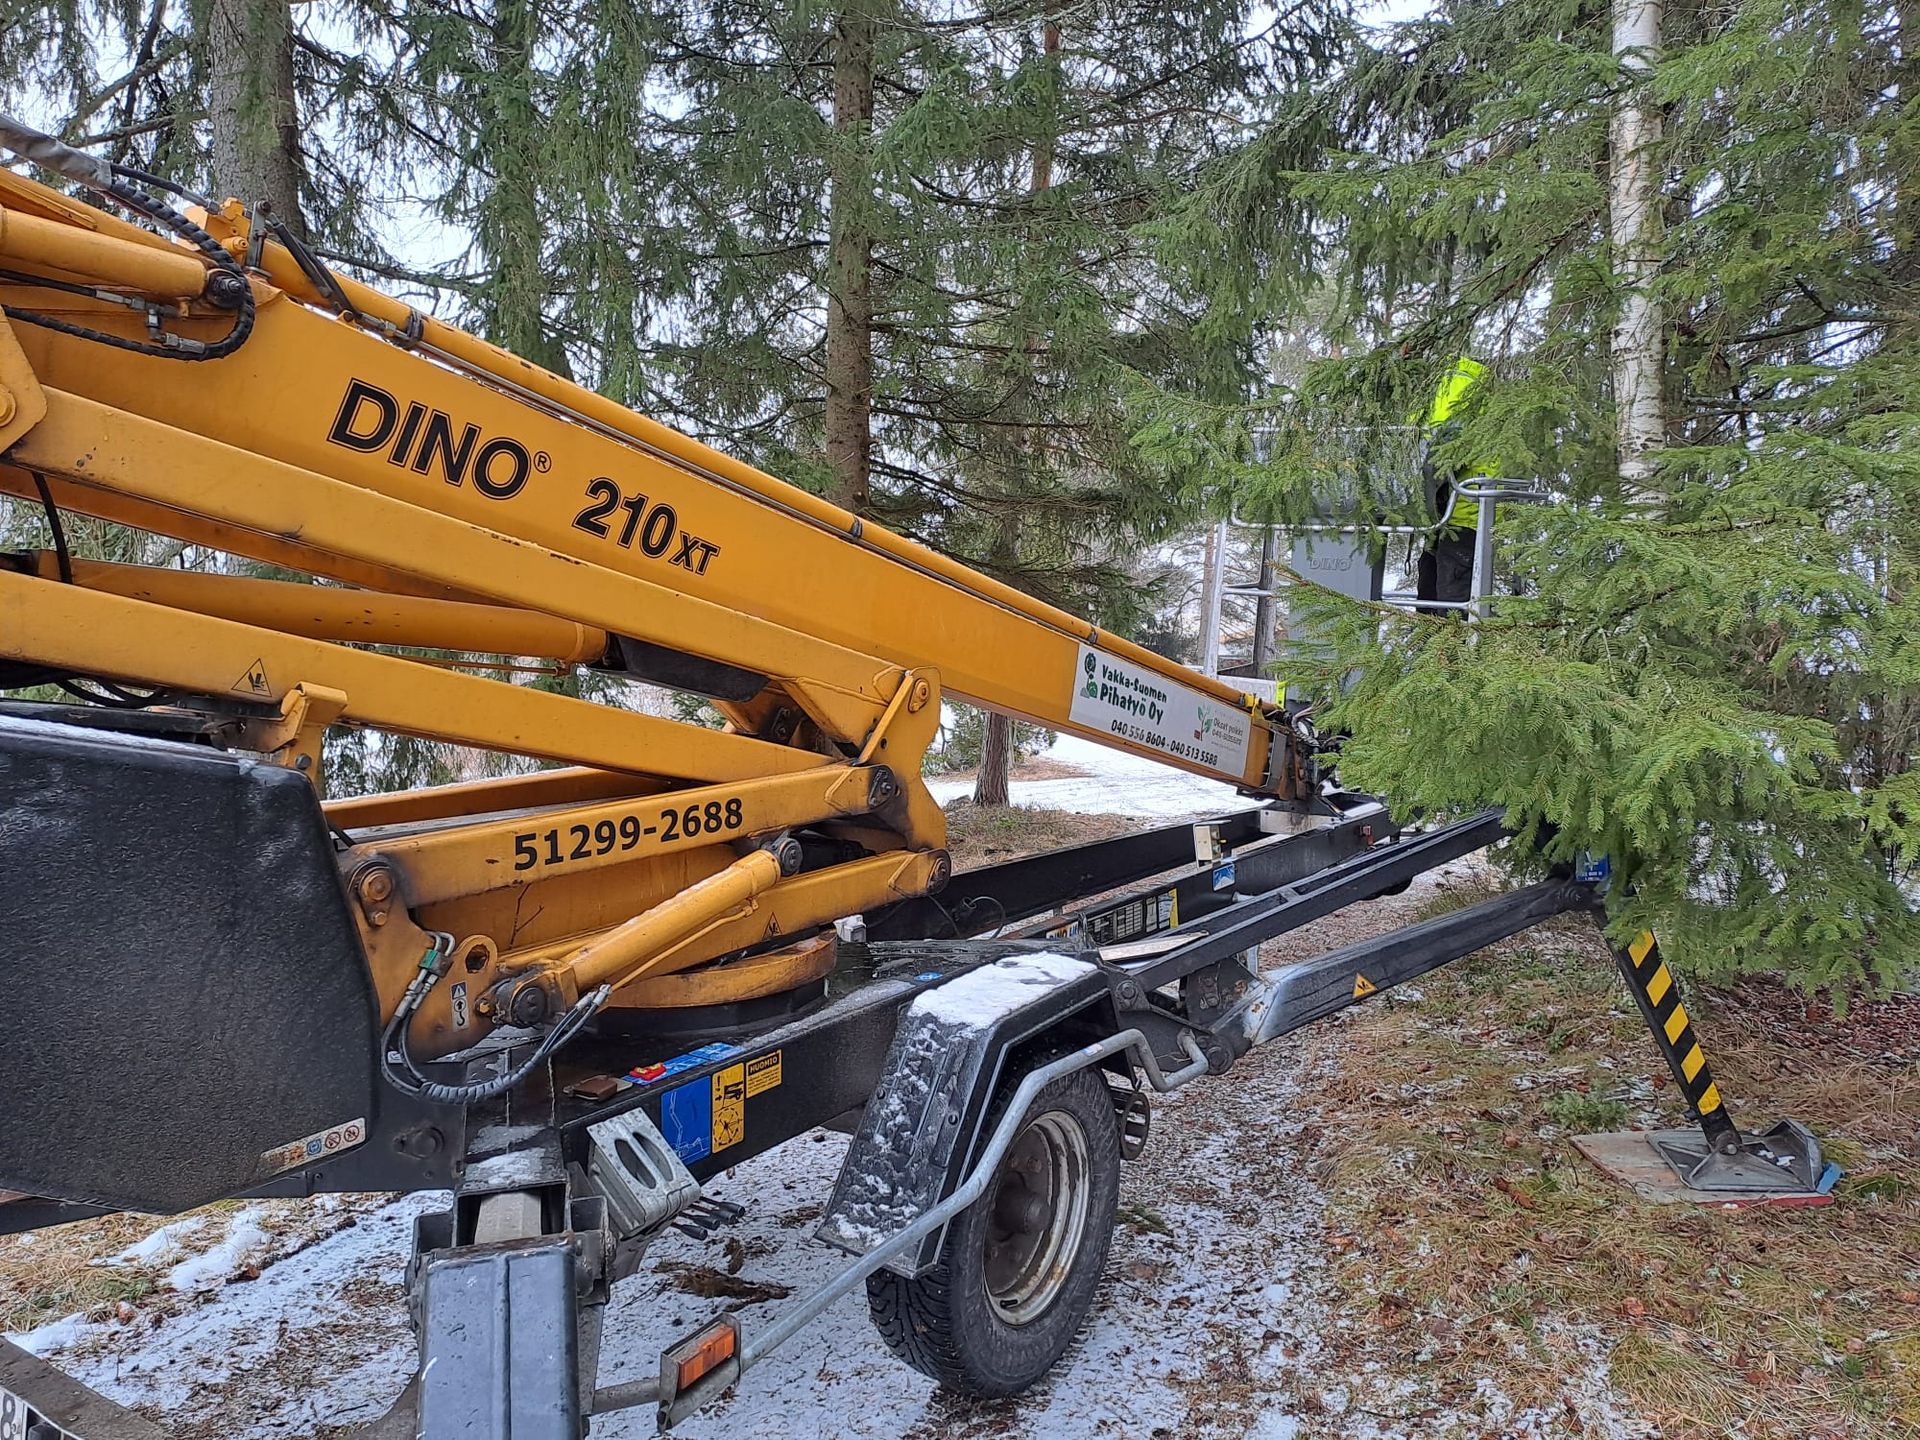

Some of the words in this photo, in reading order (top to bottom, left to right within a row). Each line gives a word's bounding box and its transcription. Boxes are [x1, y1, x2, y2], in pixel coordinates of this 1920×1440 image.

[1309, 558, 1351, 571] DINO
[1100, 682, 1146, 717] Pihatyö
[1148, 699, 1164, 725] Oy
[1102, 664, 1167, 703] Vakka-Suomen
[1111, 719, 1128, 736] 040
[1128, 725, 1144, 741] 556
[1145, 732, 1165, 748] 8604
[1170, 740, 1184, 755] 040
[1185, 747, 1199, 760] 513
[1200, 751, 1218, 766] 5588
[514, 798, 743, 870] 51299-2688
